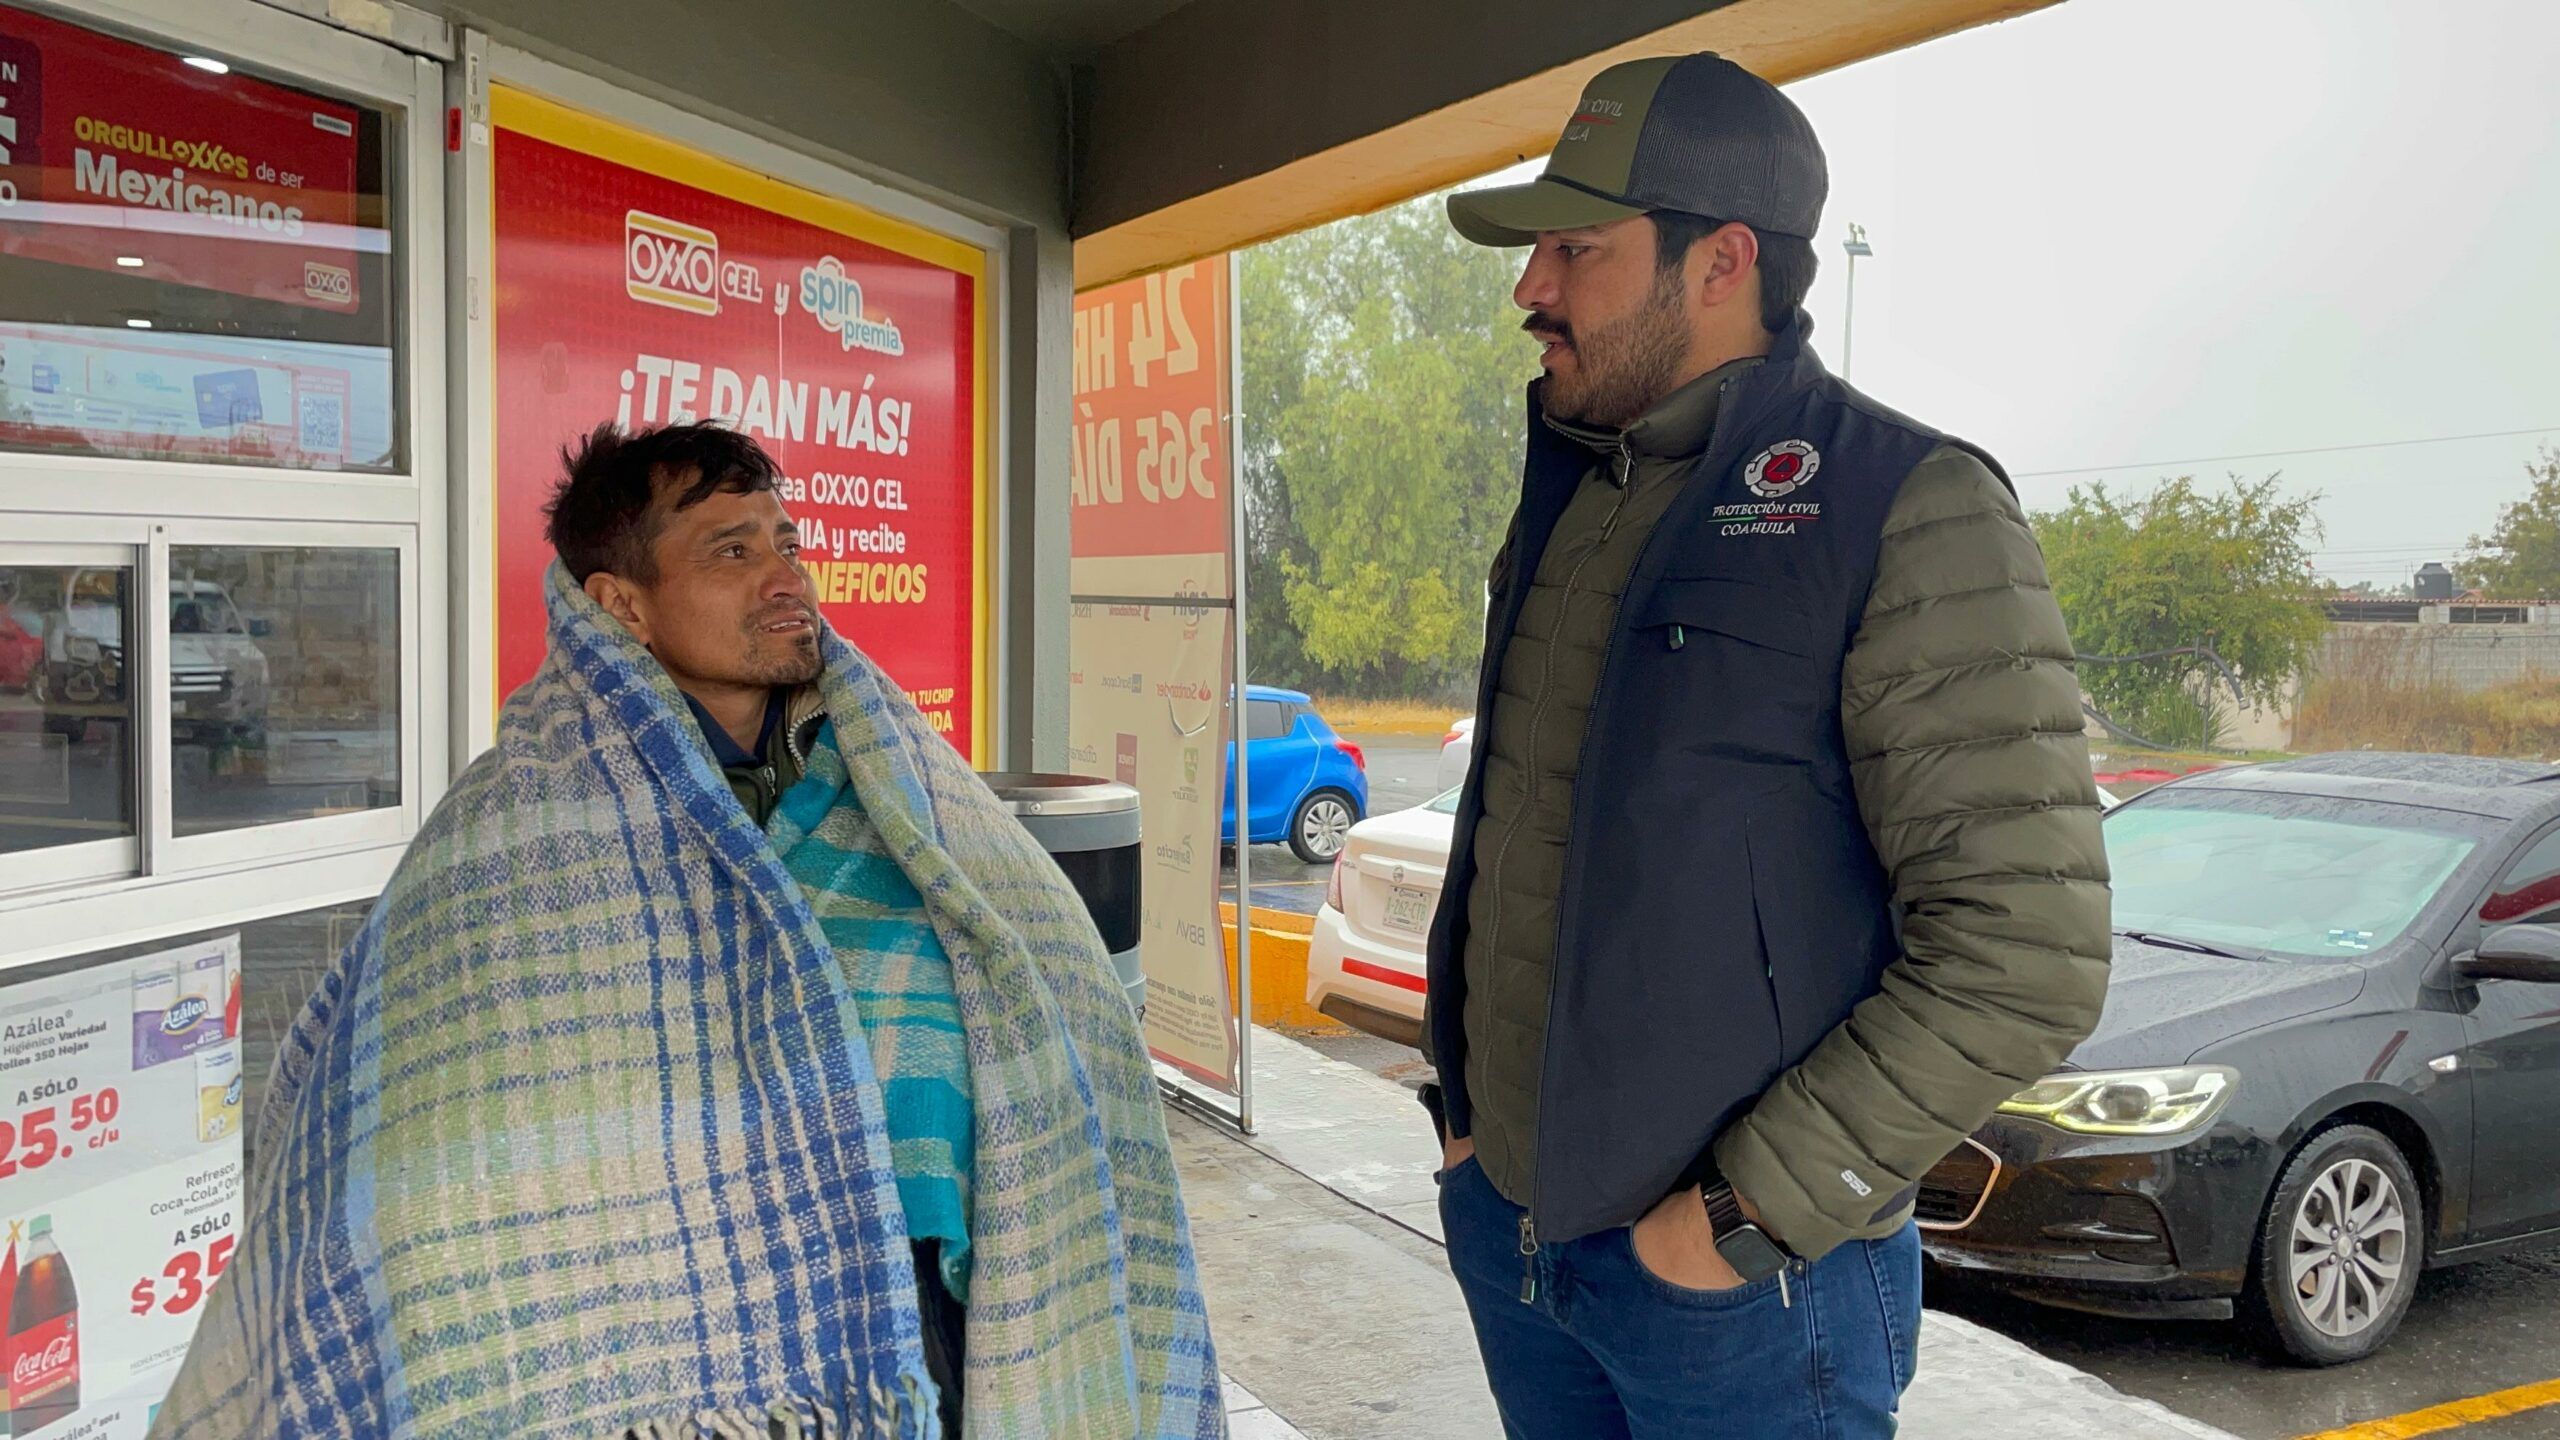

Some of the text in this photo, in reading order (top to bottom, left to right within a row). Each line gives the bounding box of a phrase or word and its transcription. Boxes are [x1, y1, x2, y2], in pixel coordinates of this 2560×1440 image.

[1591, 99, 1624, 117] CIVIL
[74, 115, 304, 189] ORGULLOXXOS de ser
[74, 148, 304, 237] Mexicanos
[307, 271, 349, 293] OXXO
[631, 234, 861, 320] OXXO CEL y spin
[843, 318, 900, 350] premia
[709, 367, 809, 443] DAN
[815, 373, 912, 457] MÁS!
[811, 471, 869, 508] OXXO
[873, 478, 908, 511] CEL
[1712, 501, 1821, 517] PROTECCIÓN CIVIL
[832, 527, 844, 559] y
[849, 522, 906, 554] recibe
[1721, 522, 1796, 536] COAHUILA
[800, 560, 927, 604] NEFICIOS
[919, 690, 932, 706] TU
[932, 687, 954, 704] CHIP
[161, 998, 208, 1031] Azálea
[58, 1020, 107, 1042] Variedad
[34, 1048, 56, 1062] 350
[58, 1041, 90, 1057] Hojas
[17, 1077, 79, 1106] A SÓLO
[88, 1128, 120, 1150] c/u
[185, 1163, 235, 1189] Refresco
[174, 1211, 231, 1247] A SÓLO
